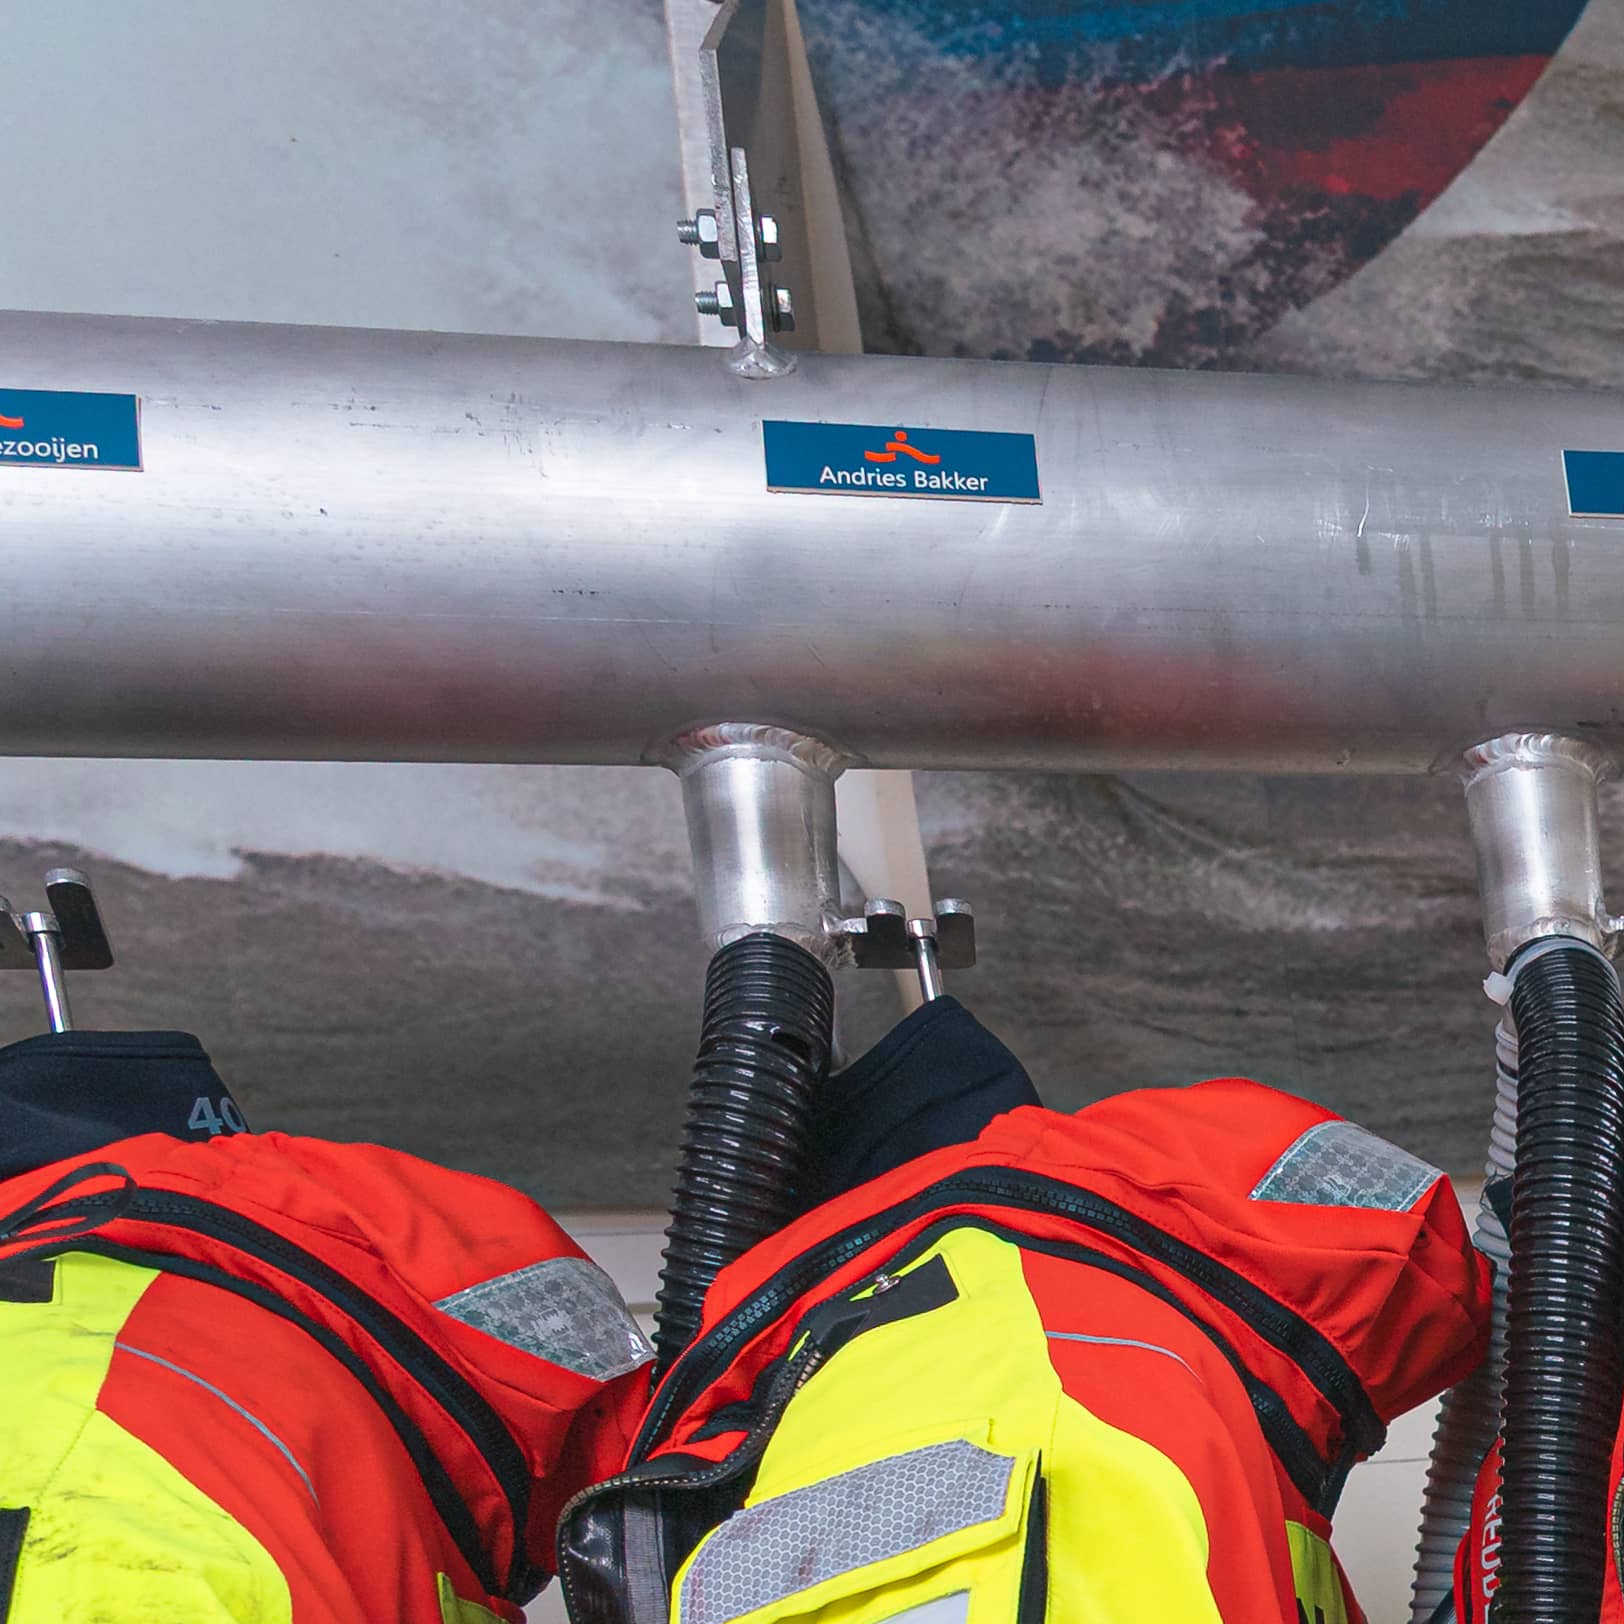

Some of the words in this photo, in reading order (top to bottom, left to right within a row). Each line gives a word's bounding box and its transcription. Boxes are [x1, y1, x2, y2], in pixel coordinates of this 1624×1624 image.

[0, 437, 98, 463] zooijen
[819, 465, 907, 488] Andries
[914, 470, 989, 491] Bakker
[187, 1097, 247, 1135] 40
